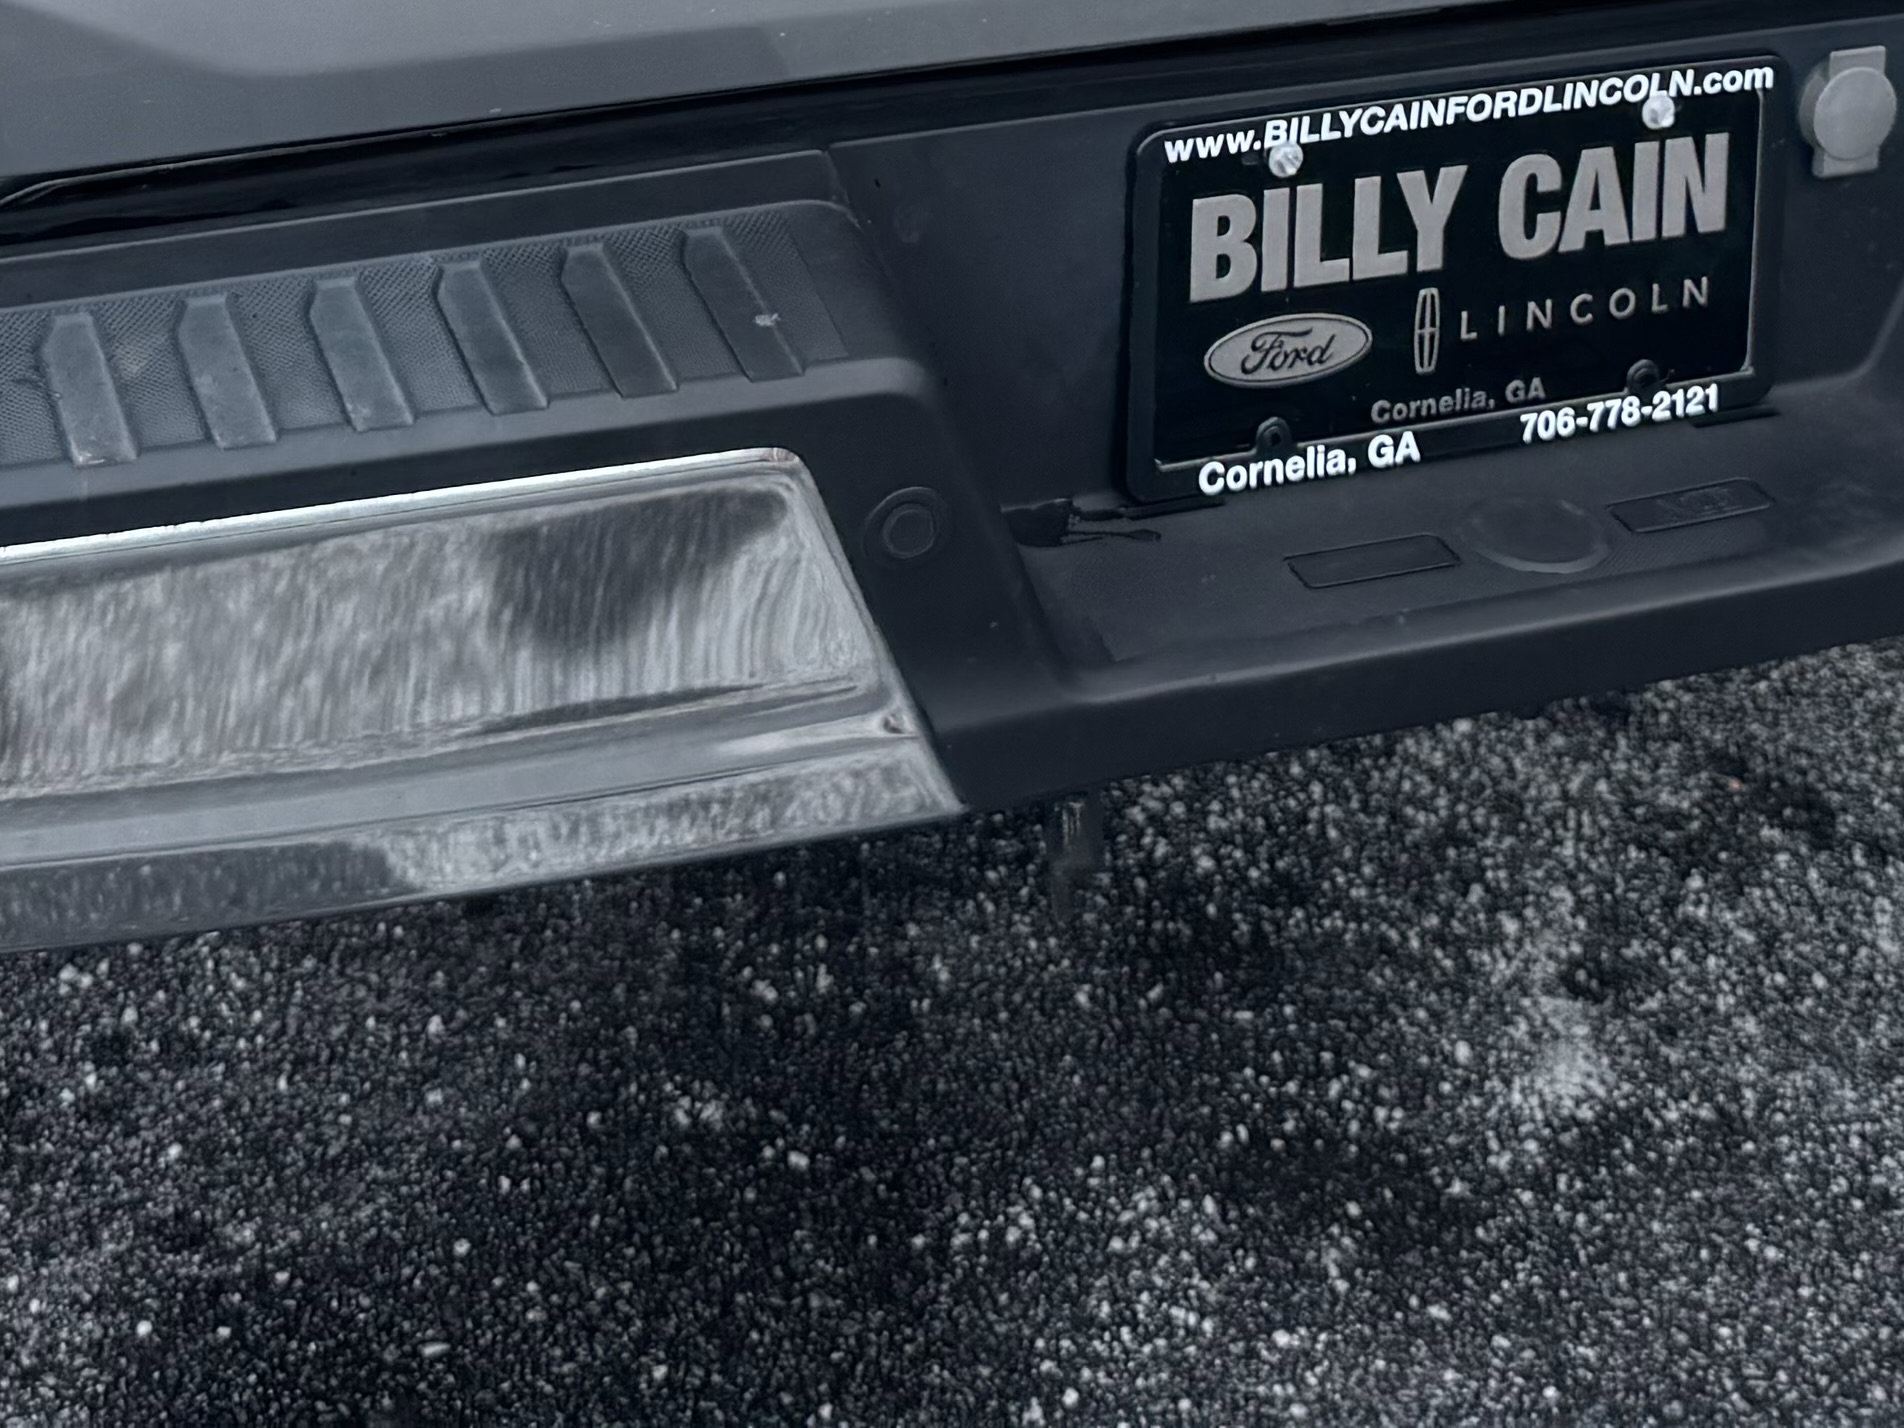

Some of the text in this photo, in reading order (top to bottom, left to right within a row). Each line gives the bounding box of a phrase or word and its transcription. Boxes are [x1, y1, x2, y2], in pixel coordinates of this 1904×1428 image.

[1163, 66, 1774, 164] www.BILLYCAINFORDLINCOLN.com
[1189, 132, 1730, 303] BILLY CAIN
[1460, 276, 1710, 341] LINCOLN
[1240, 327, 1335, 375] Ford
[1371, 376, 1547, 425] Cornelia, GA
[1520, 383, 1719, 444] 706-778-2121
[1198, 430, 1422, 497] Cornelia, GA
